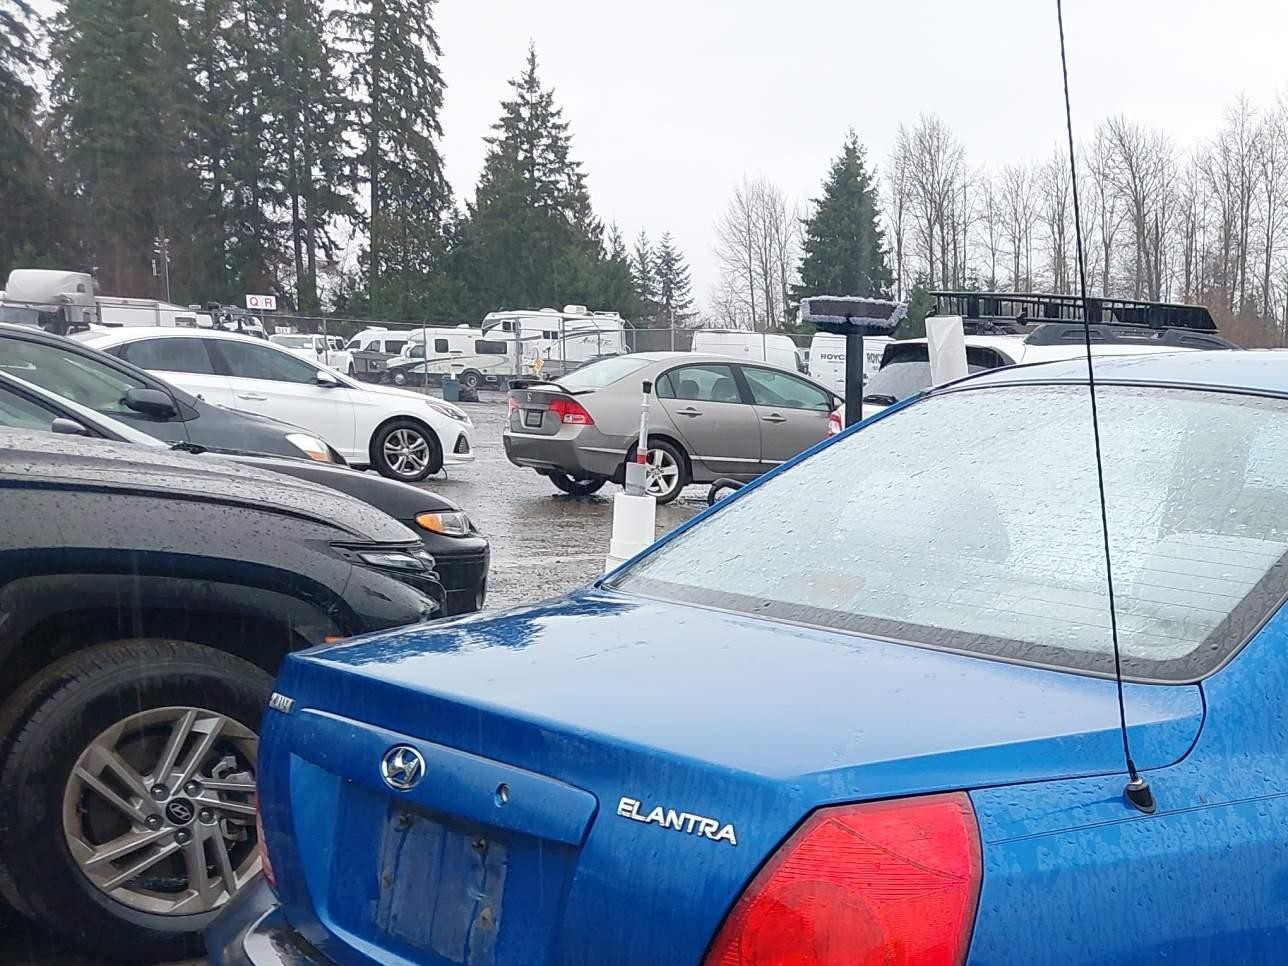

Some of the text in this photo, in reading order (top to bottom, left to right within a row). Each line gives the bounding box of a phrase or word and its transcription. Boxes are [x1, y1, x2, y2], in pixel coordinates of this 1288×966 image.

[249, 296, 272, 307] Q R
[617, 796, 737, 845] ELANTRA
